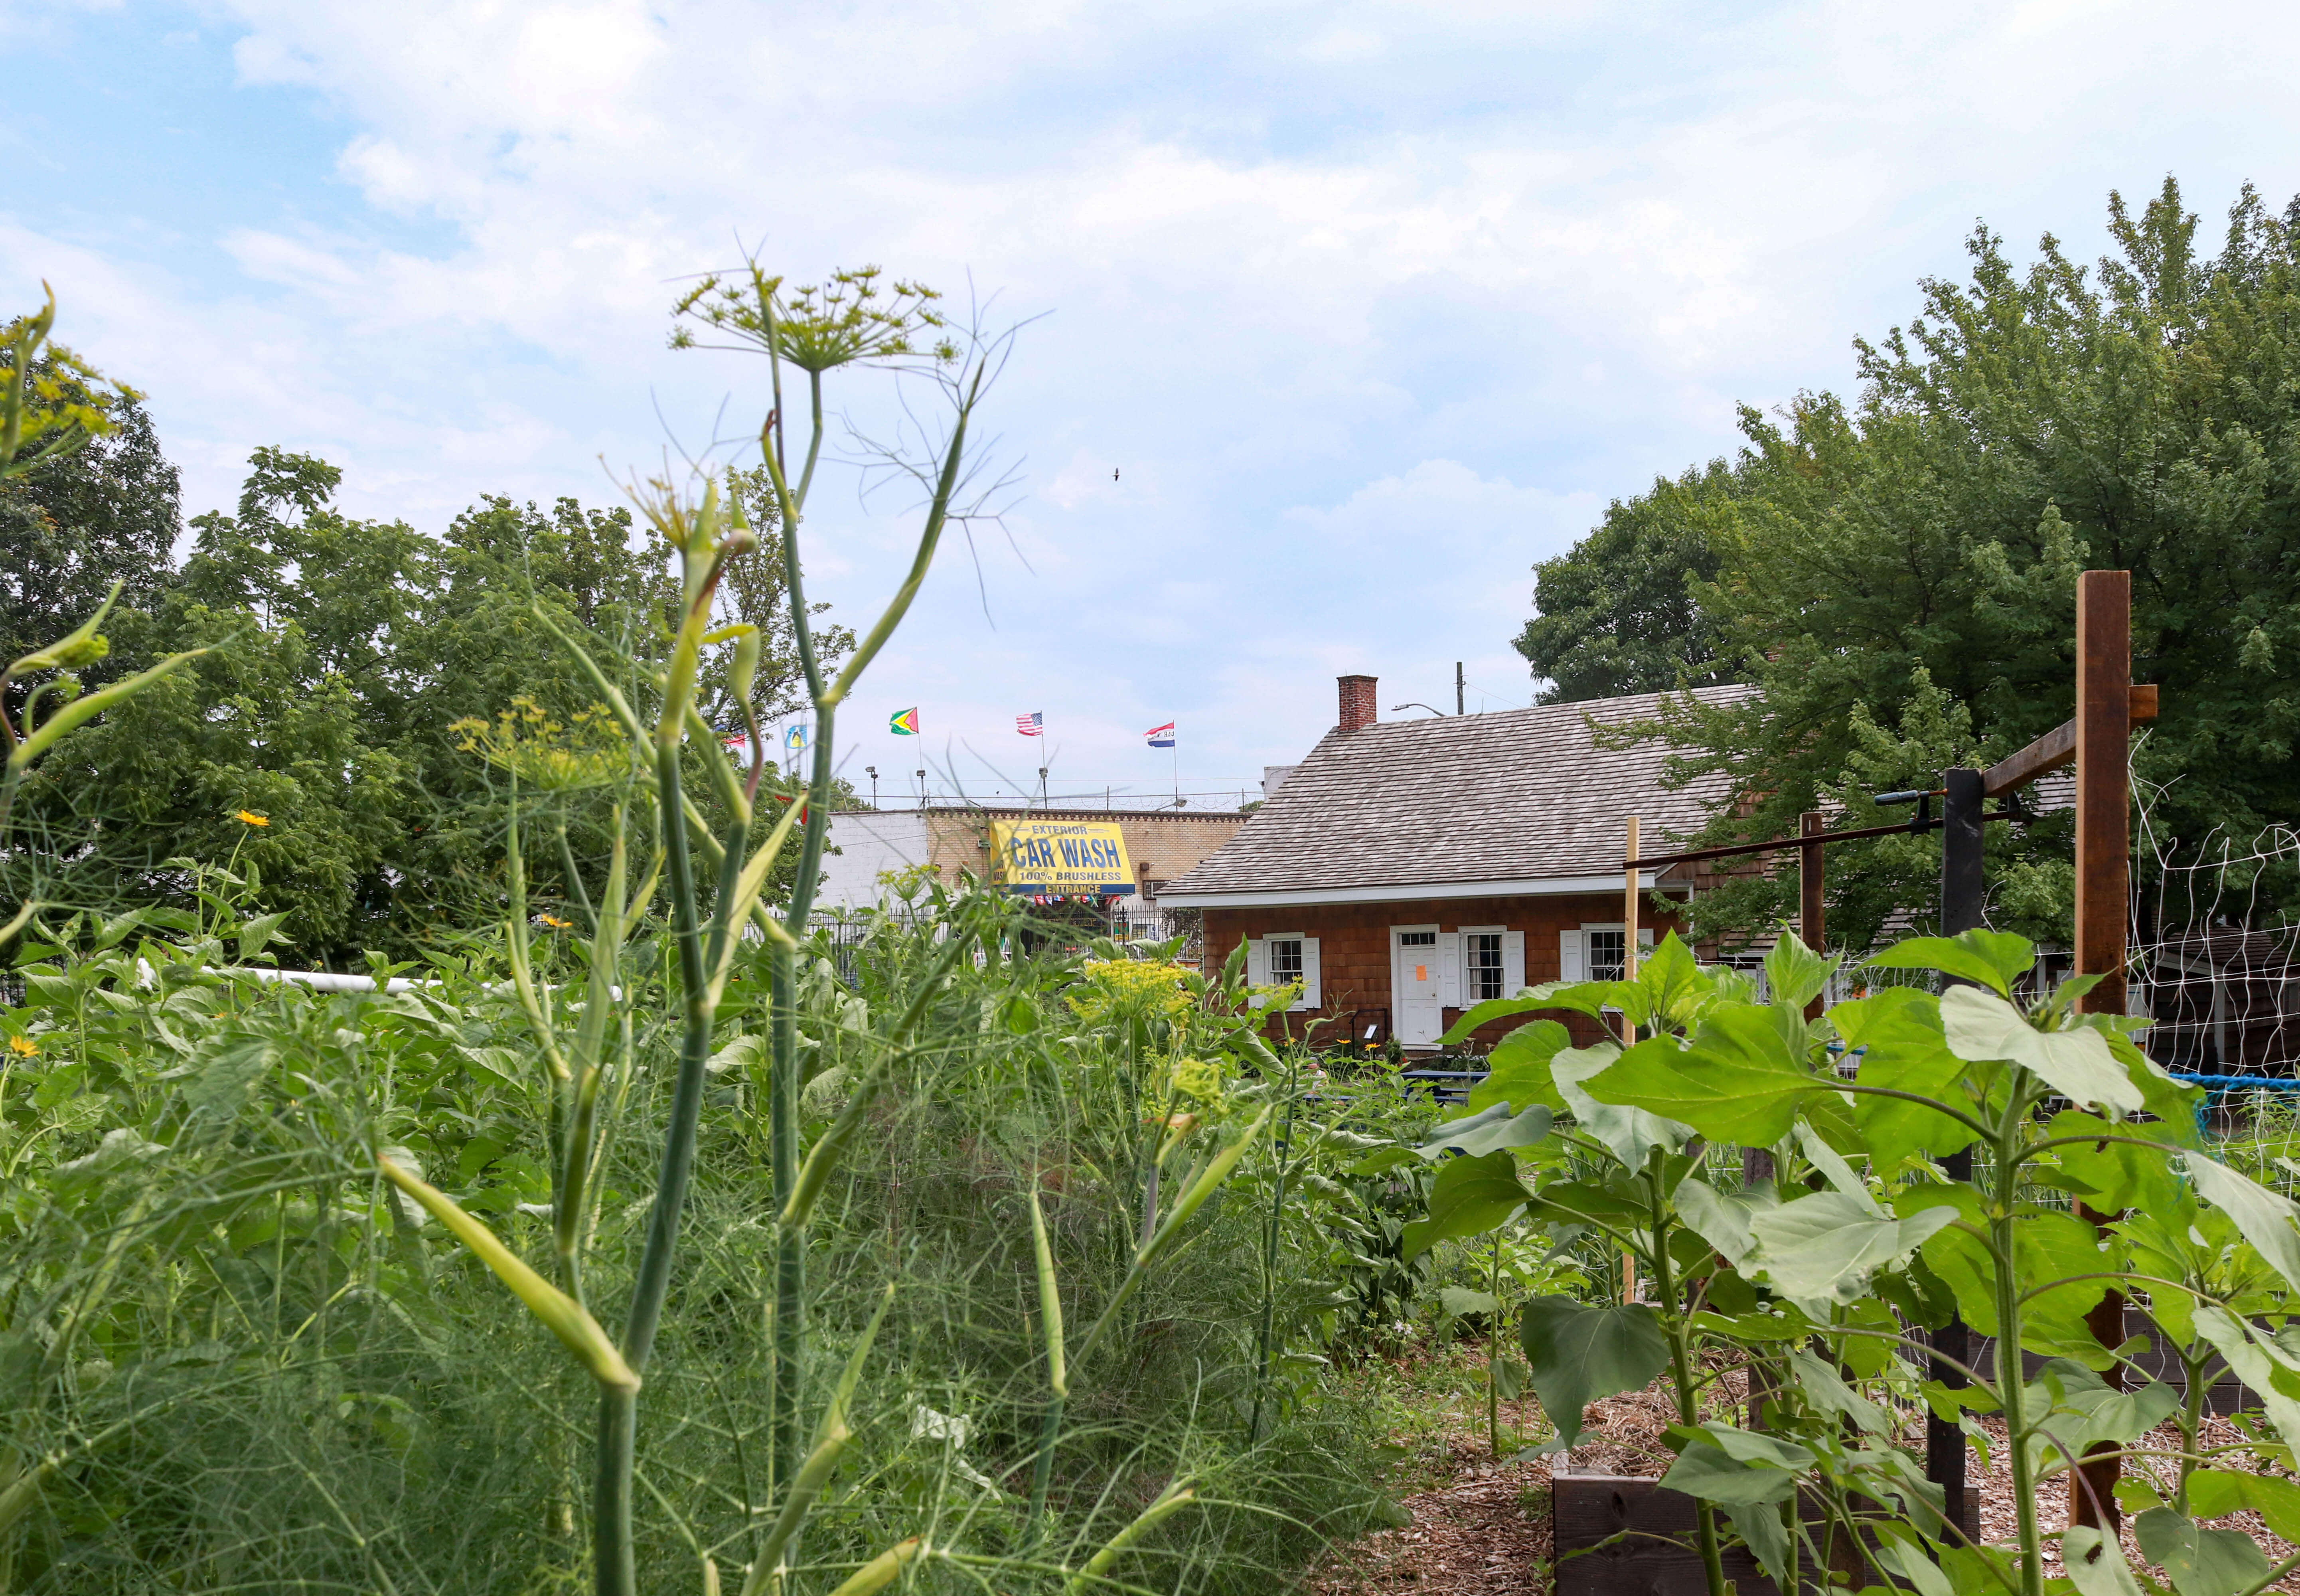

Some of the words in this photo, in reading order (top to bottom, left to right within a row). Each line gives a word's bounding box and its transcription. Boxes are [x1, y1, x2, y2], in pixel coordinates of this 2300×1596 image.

[1032, 826, 1088, 835] EXTERIOR
[1010, 837, 1056, 868] CAR
[1057, 839, 1121, 868] WASH
[1046, 885, 1101, 893] ENTRANCE
